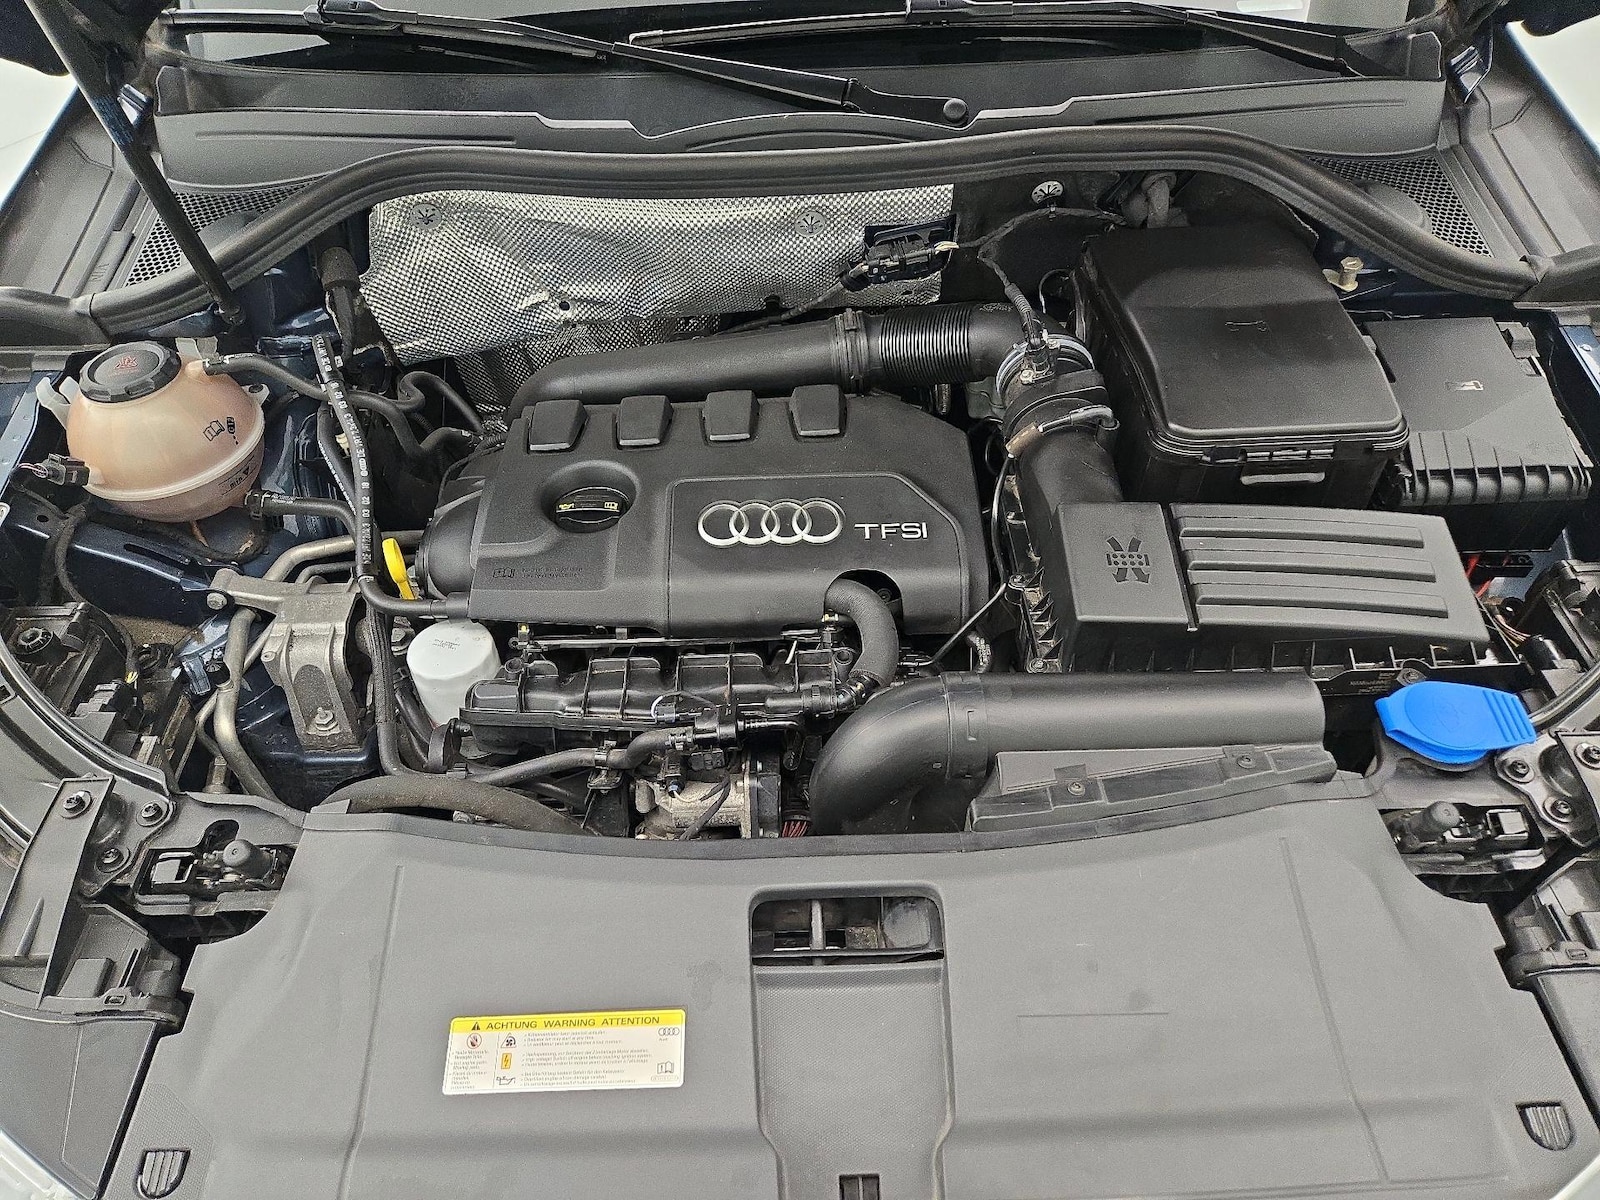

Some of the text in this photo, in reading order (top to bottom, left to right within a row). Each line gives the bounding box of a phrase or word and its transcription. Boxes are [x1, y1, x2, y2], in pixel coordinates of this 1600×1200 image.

[334, 390, 344, 400] 02
[356, 448, 366, 458] DE
[229, 476, 243, 489] min
[361, 482, 370, 490] 18
[361, 496, 370, 505] 02
[854, 522, 928, 540] TFSI
[486, 1016, 660, 1030] ACHTUNG WARNING ATTENTION
